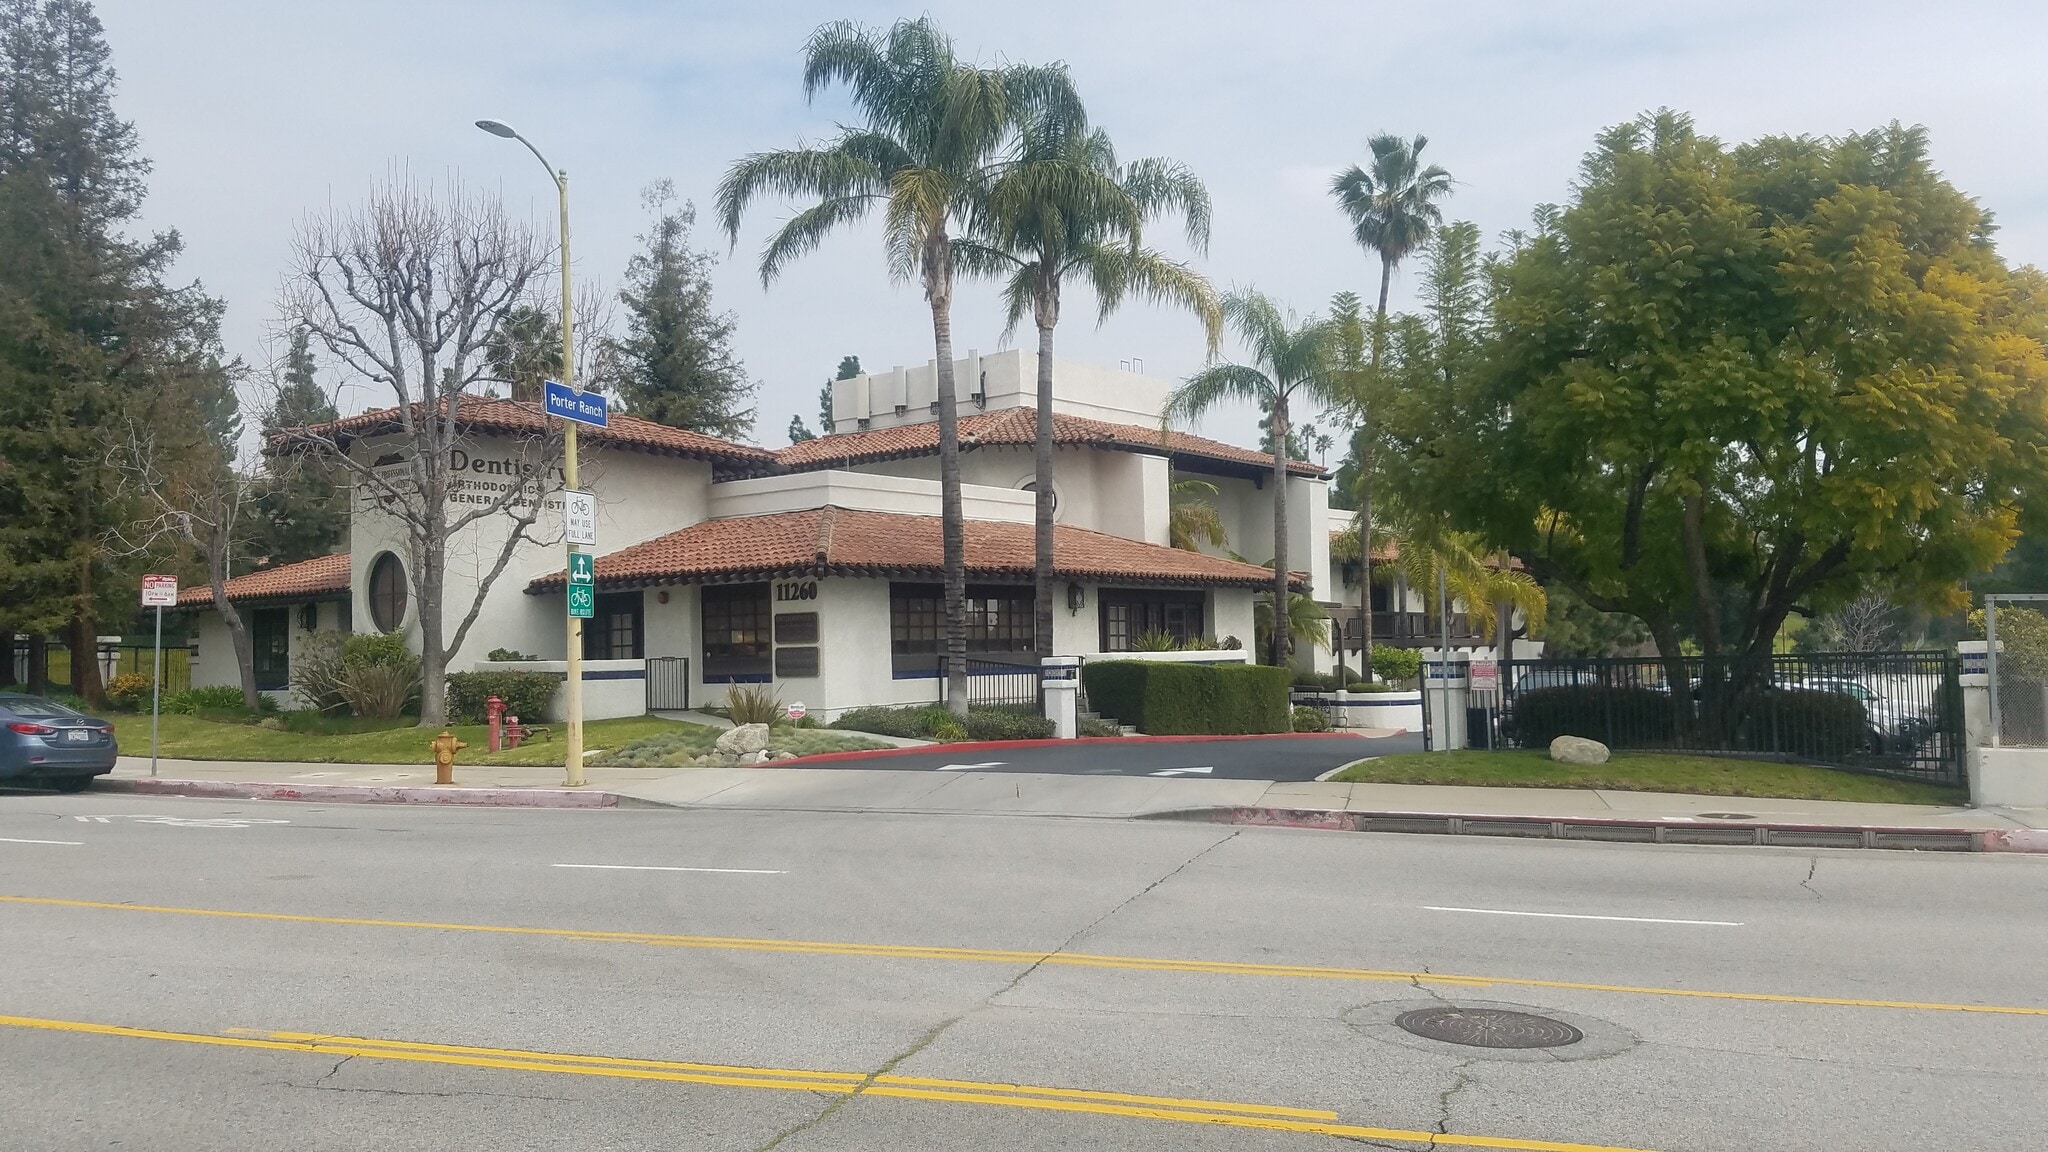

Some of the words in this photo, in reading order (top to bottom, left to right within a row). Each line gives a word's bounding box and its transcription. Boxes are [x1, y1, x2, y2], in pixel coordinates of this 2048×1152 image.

[550, 392, 576, 411] Porter
[579, 400, 603, 418] Ranch
[449, 449, 567, 487] Dentisry
[449, 493, 507, 506] GENERA
[570, 518, 580, 527] MAY
[581, 519, 591, 529] USE
[568, 529, 580, 539] FULL
[582, 530, 594, 541] LANE
[144, 580, 154, 589] NO
[776, 581, 818, 601] 11260
